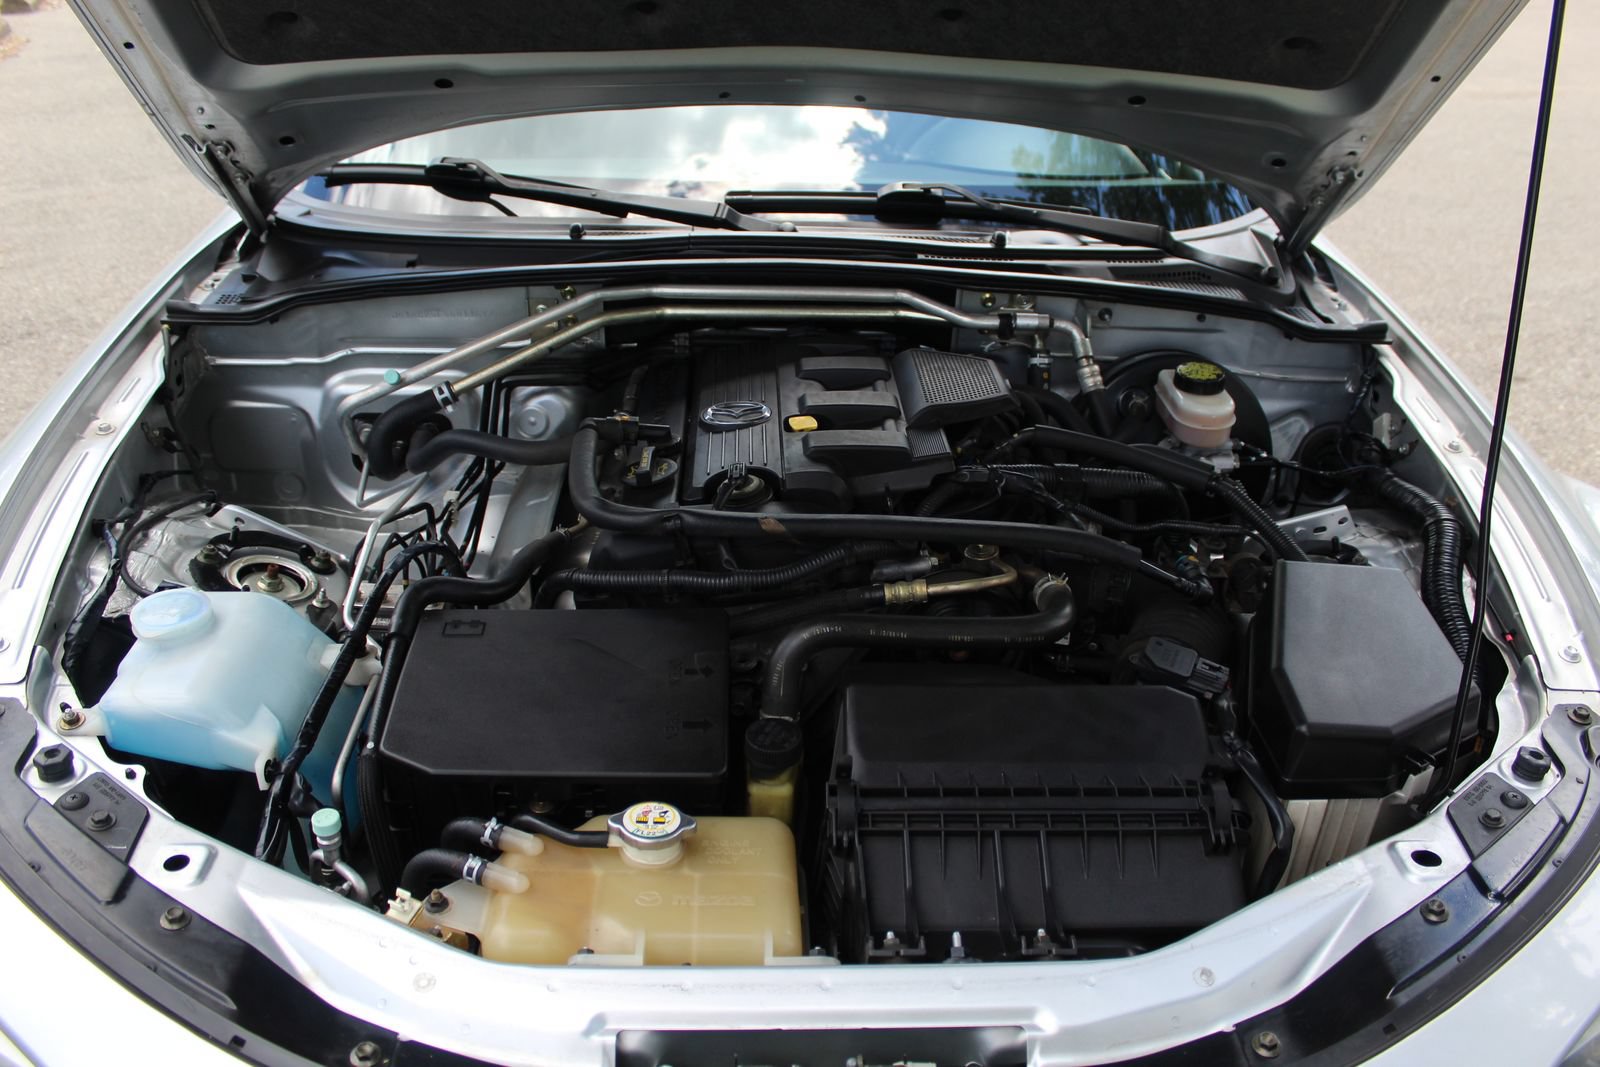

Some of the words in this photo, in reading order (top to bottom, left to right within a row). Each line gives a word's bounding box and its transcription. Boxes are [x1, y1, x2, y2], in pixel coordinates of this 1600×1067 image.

[701, 839, 751, 847] ENGINE
[704, 847, 762, 856] COOLANT
[707, 855, 740, 865] ONLY
